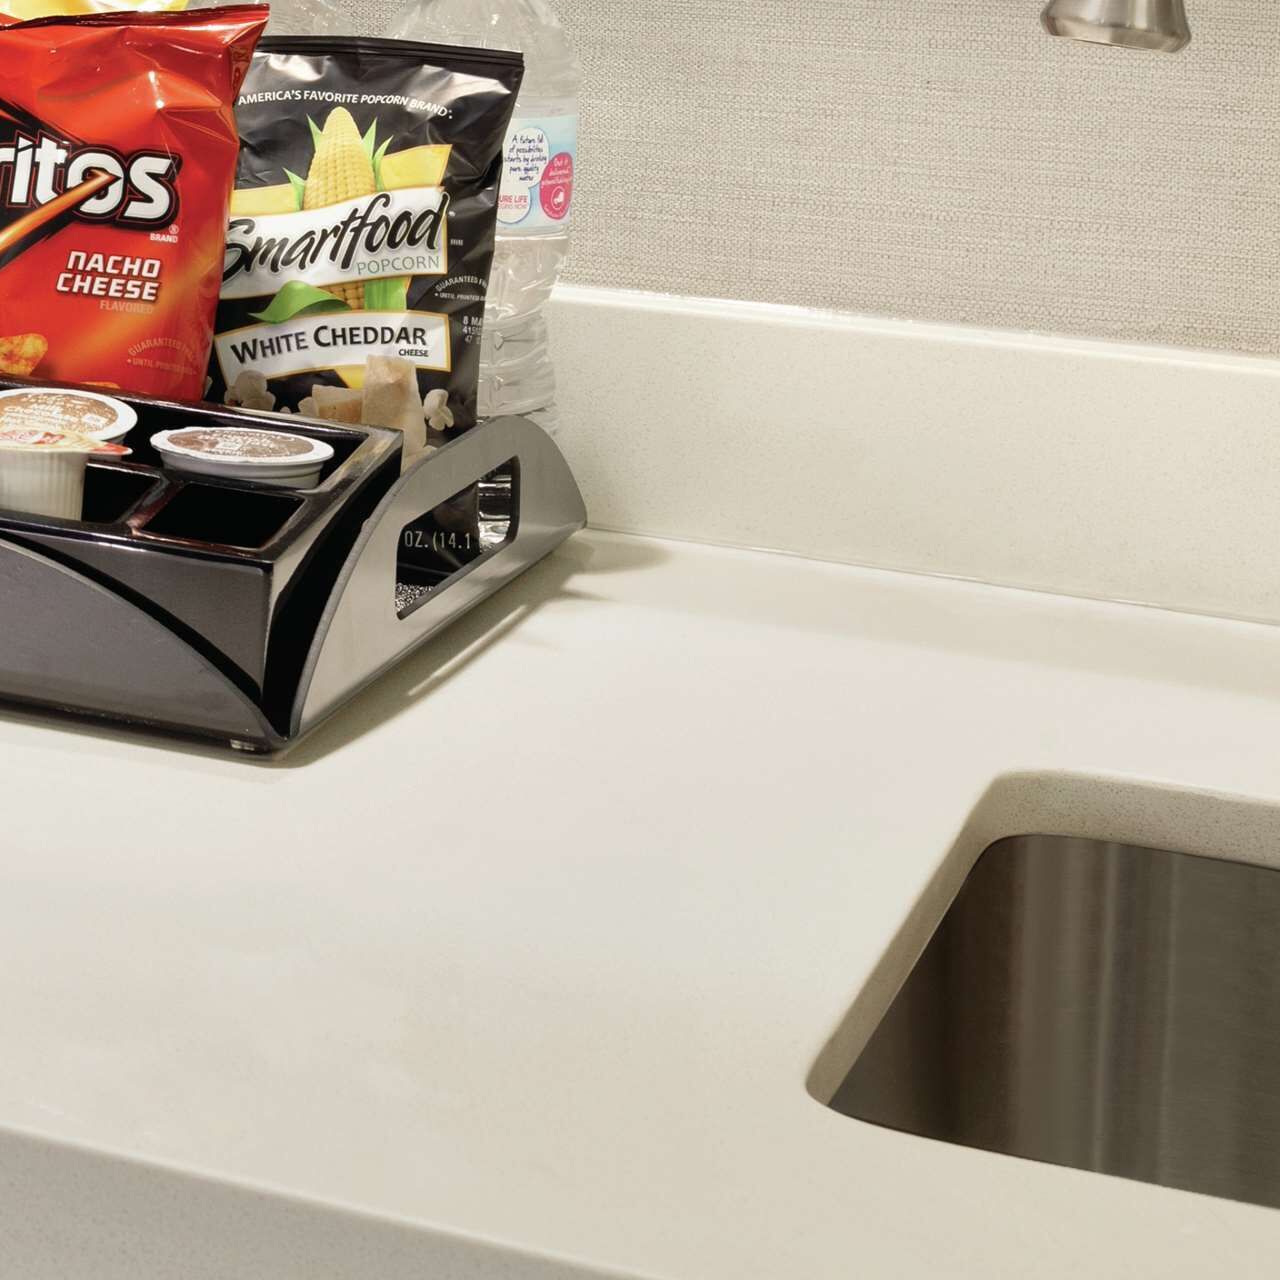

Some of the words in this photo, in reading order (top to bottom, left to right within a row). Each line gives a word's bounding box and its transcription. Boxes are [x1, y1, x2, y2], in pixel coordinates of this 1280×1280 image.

[237, 89, 302, 106] AMERICA'S
[303, 90, 358, 104] FAVORITE
[360, 94, 409, 106] POPCORN
[149, 233, 178, 244] BRAND
[222, 192, 449, 282] Smartfood
[66, 250, 161, 278] NACHO
[356, 255, 439, 276] POPCORN
[55, 272, 160, 301] CHEESE
[434, 275, 478, 293] GUARANTEED
[99, 299, 153, 314] FLAVORED
[230, 331, 309, 365] WHITE
[313, 325, 427, 347] CHEDDAR
[398, 348, 429, 358] CHEESE
[404, 530, 429, 548] OZ.
[432, 531, 471, 553] (14.1
